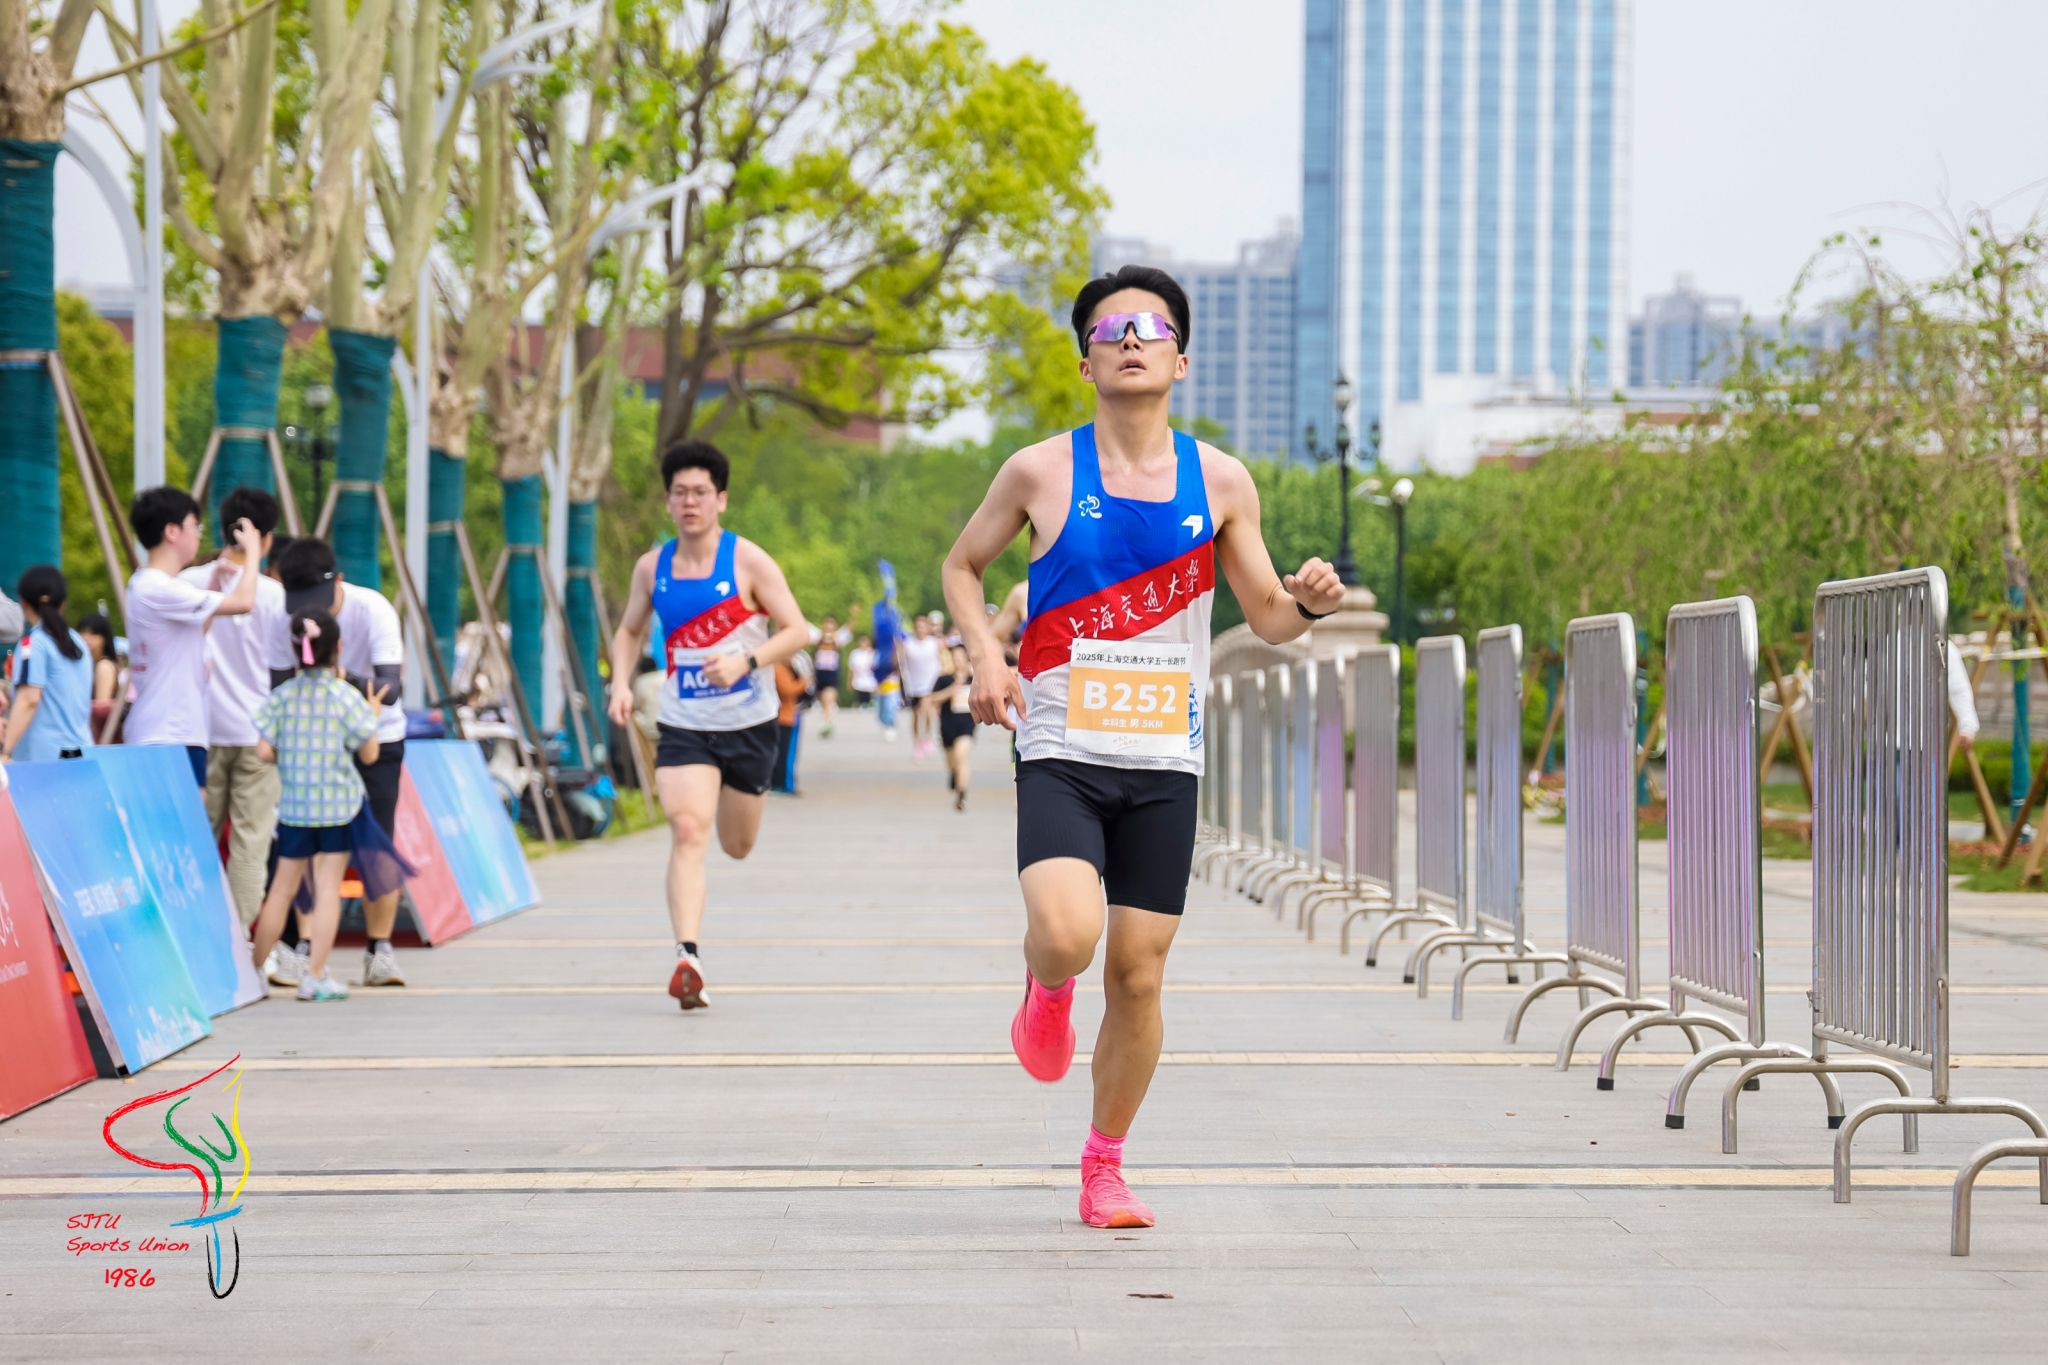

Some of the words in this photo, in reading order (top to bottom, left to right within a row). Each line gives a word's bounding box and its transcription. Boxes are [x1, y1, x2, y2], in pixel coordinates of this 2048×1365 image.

[1083, 680, 1177, 714] B252
[1129, 718, 1140, 729] 男
[1142, 719, 1164, 729] 5KM
